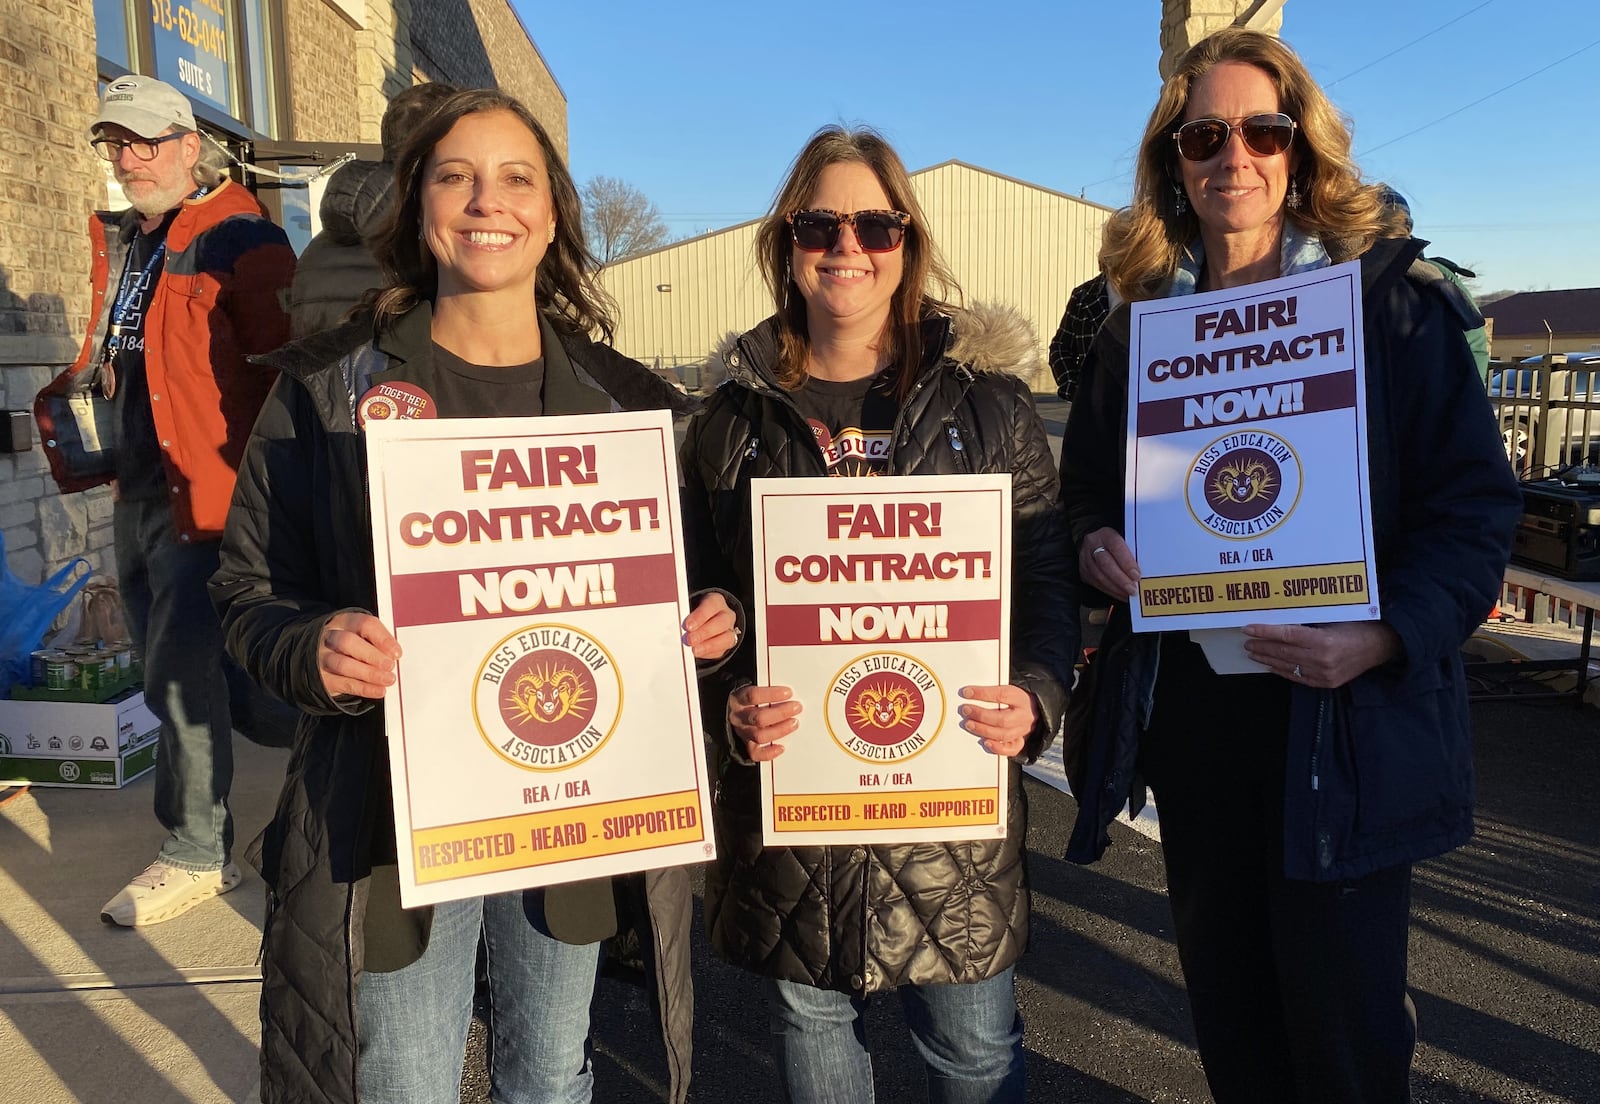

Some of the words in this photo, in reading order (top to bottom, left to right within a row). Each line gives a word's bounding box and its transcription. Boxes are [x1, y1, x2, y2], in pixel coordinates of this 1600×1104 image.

[178, 57, 205, 92] SUITE
[206, 71, 213, 96] S
[1195, 296, 1297, 342] FAIR!
[1148, 328, 1344, 383] CONTRACT!
[379, 384, 427, 409] TOGETHER
[406, 405, 422, 418] WE
[1184, 381, 1305, 428] NOW!!
[460, 444, 598, 493] FAIR!
[1194, 447, 1220, 476] ROSS
[1223, 434, 1292, 464] EDUCATION
[399, 498, 660, 547] CONTRACT!
[827, 502, 942, 541] FAIR!
[1204, 505, 1284, 535] ASSOCIATION
[775, 551, 992, 583] CONTRACT!
[1219, 551, 1240, 565] REA
[1252, 548, 1273, 562] OEA
[458, 562, 617, 616] NOW!!
[1144, 585, 1214, 607] RESPECTED
[1226, 581, 1270, 601] HEARD
[1283, 574, 1364, 598] SUPPORTED
[819, 604, 949, 642] NOW!!
[483, 646, 516, 685] ROSS
[518, 630, 608, 672] EDUCATION
[833, 666, 861, 696] ROSS
[864, 656, 936, 692] EDUCATION
[501, 725, 603, 764] ASSOCIATION
[845, 732, 926, 760] ASSOCIATION
[64, 766, 75, 777] 6X
[859, 774, 880, 786] REA
[892, 773, 913, 785] OEA
[523, 784, 550, 804] REA
[565, 780, 591, 798] OEA
[778, 804, 851, 822] RESPECTED
[863, 803, 907, 821] HEARD
[919, 799, 994, 818] SUPPORTED
[419, 832, 515, 869] RESPECTED
[531, 822, 586, 851] HEARD
[603, 806, 697, 840] SUPPORTED
